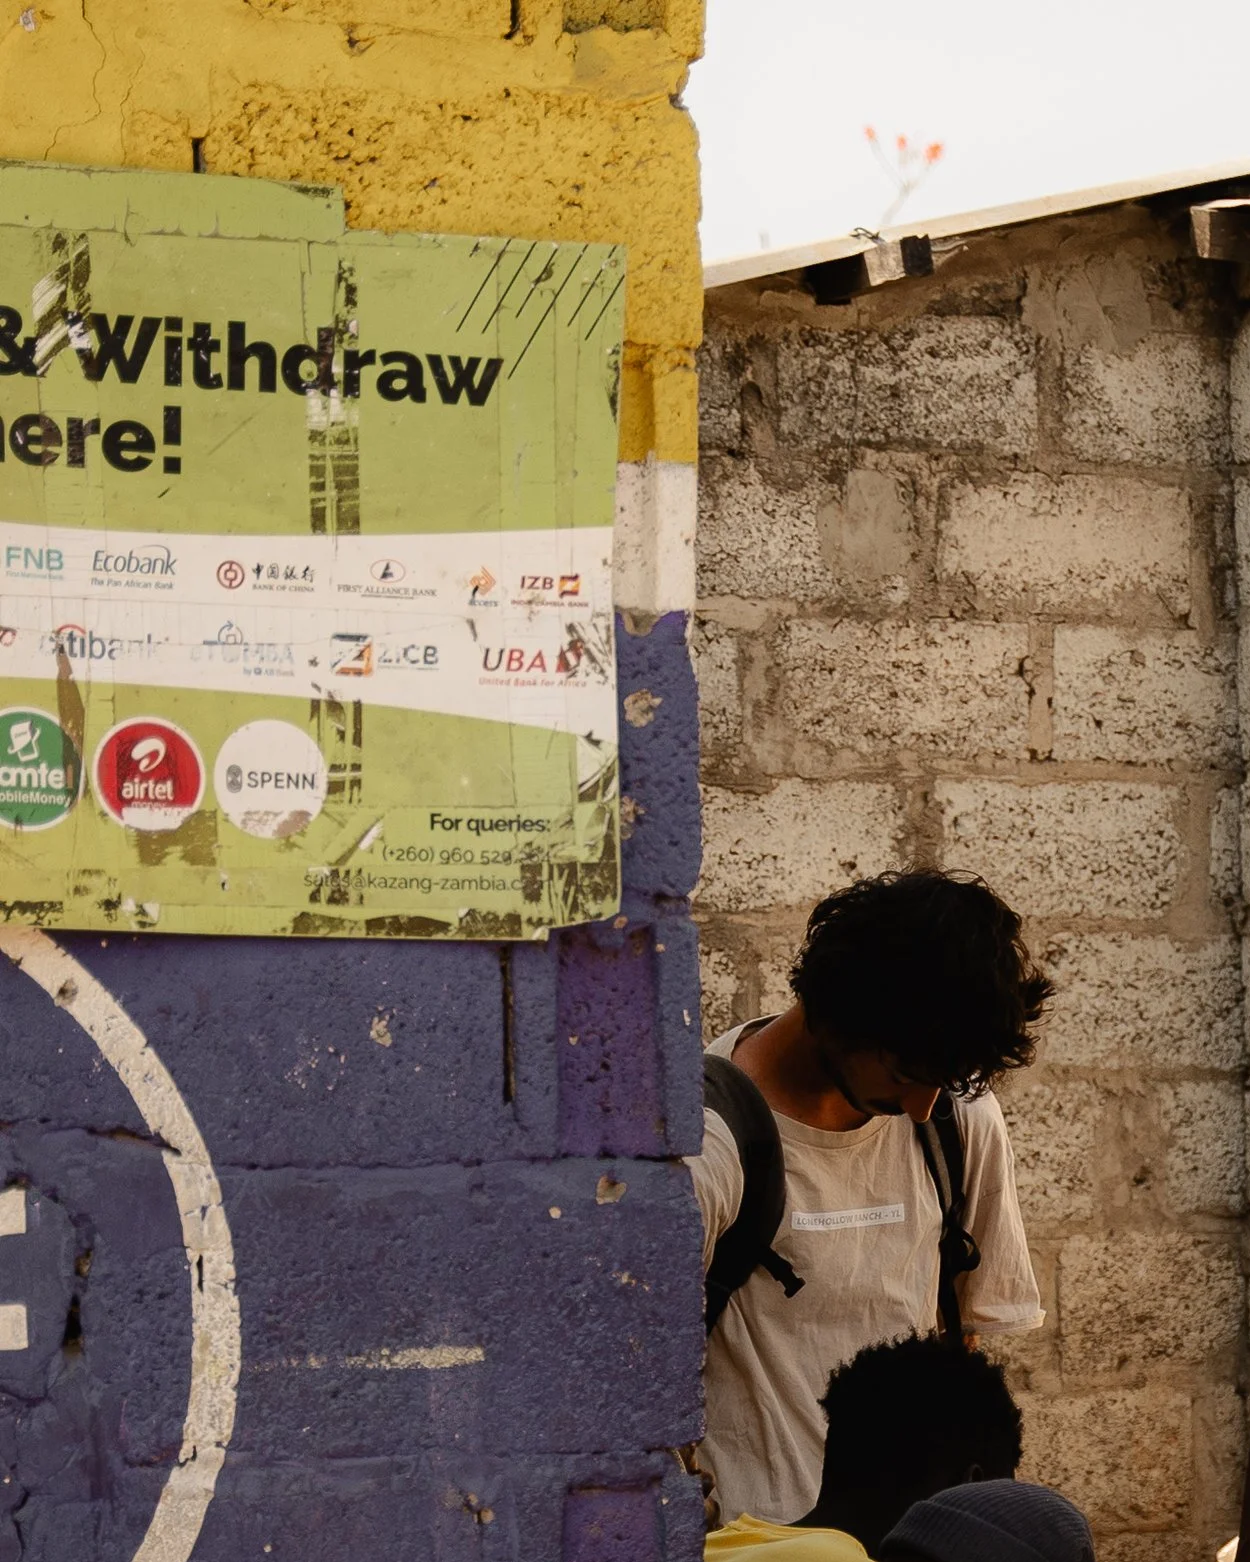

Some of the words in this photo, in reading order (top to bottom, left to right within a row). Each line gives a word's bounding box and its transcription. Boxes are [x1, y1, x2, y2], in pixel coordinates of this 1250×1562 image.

[66, 311, 504, 407] Withdraw
[0, 405, 182, 474] ere!
[6, 546, 64, 571] FNB
[92, 545, 178, 576] Ecobank
[107, 579, 121, 587] Pan
[124, 580, 151, 589] African
[154, 581, 174, 590] Bank
[289, 585, 315, 593] CHINA
[337, 584, 363, 593] FIRST
[364, 586, 410, 596] ALLIANCE
[412, 588, 438, 597] BANK
[520, 576, 554, 590] IZB
[40, 629, 164, 661] ctibank
[482, 648, 547, 673] UBA
[478, 677, 511, 687] United
[514, 677, 537, 687] Bank
[541, 678, 554, 687] for
[557, 679, 587, 688] Africa
[122, 778, 174, 801] airtel
[247, 771, 316, 790] SPENN
[430, 813, 463, 832] For
[466, 814, 551, 836] queries:
[382, 847, 434, 864] (+260)
[439, 848, 474, 865] 960
[303, 872, 548, 894] sales@kazang-zambia.c
